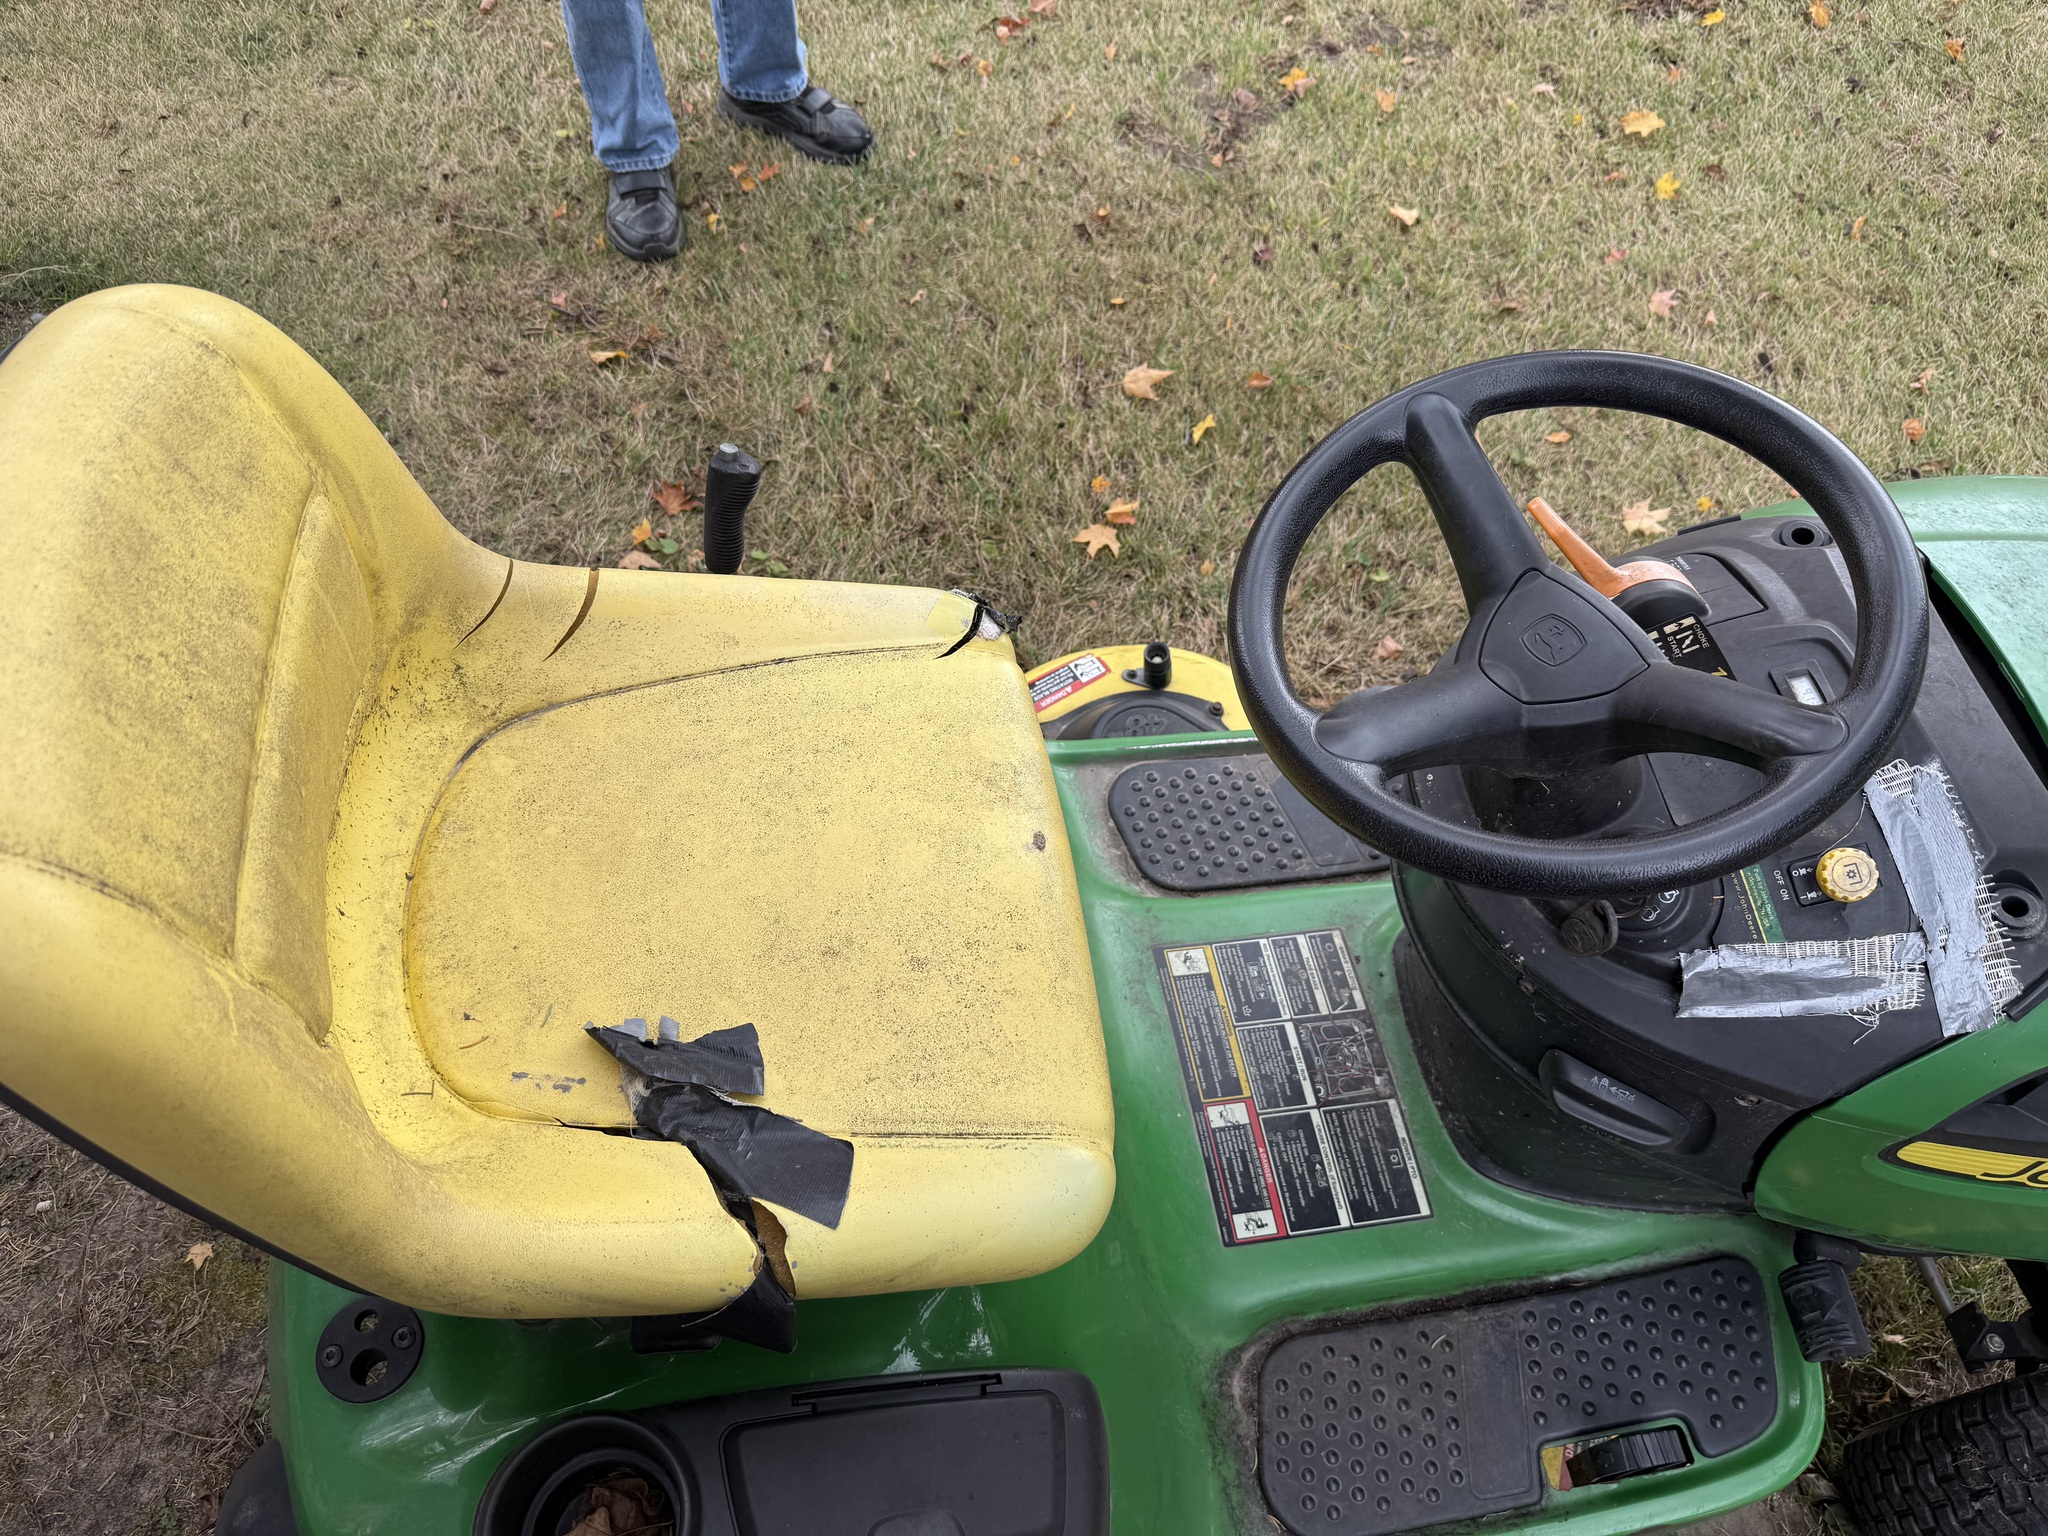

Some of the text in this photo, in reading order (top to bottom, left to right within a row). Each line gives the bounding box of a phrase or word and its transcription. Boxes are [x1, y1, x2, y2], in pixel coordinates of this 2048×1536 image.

[1667, 636, 1682, 658] START
[1693, 624, 1710, 648] CHOKE
[1040, 690, 1067, 707] DANGER
[1126, 716, 1167, 735] 48
[1773, 869, 1789, 901] OFF ON
[1760, 889, 1769, 904] John
[1765, 904, 1775, 920] Deere
[1222, 1010, 1233, 1036] WARNING
[1293, 1046, 1302, 1064] START
[1228, 1059, 1237, 1077] DEATH
[1316, 1124, 1325, 1145] CRUISE
[1322, 1146, 1333, 1173] CONTROL
[1401, 1137, 1412, 1161] MOWER
[1261, 1154, 1272, 1183] DANGER
